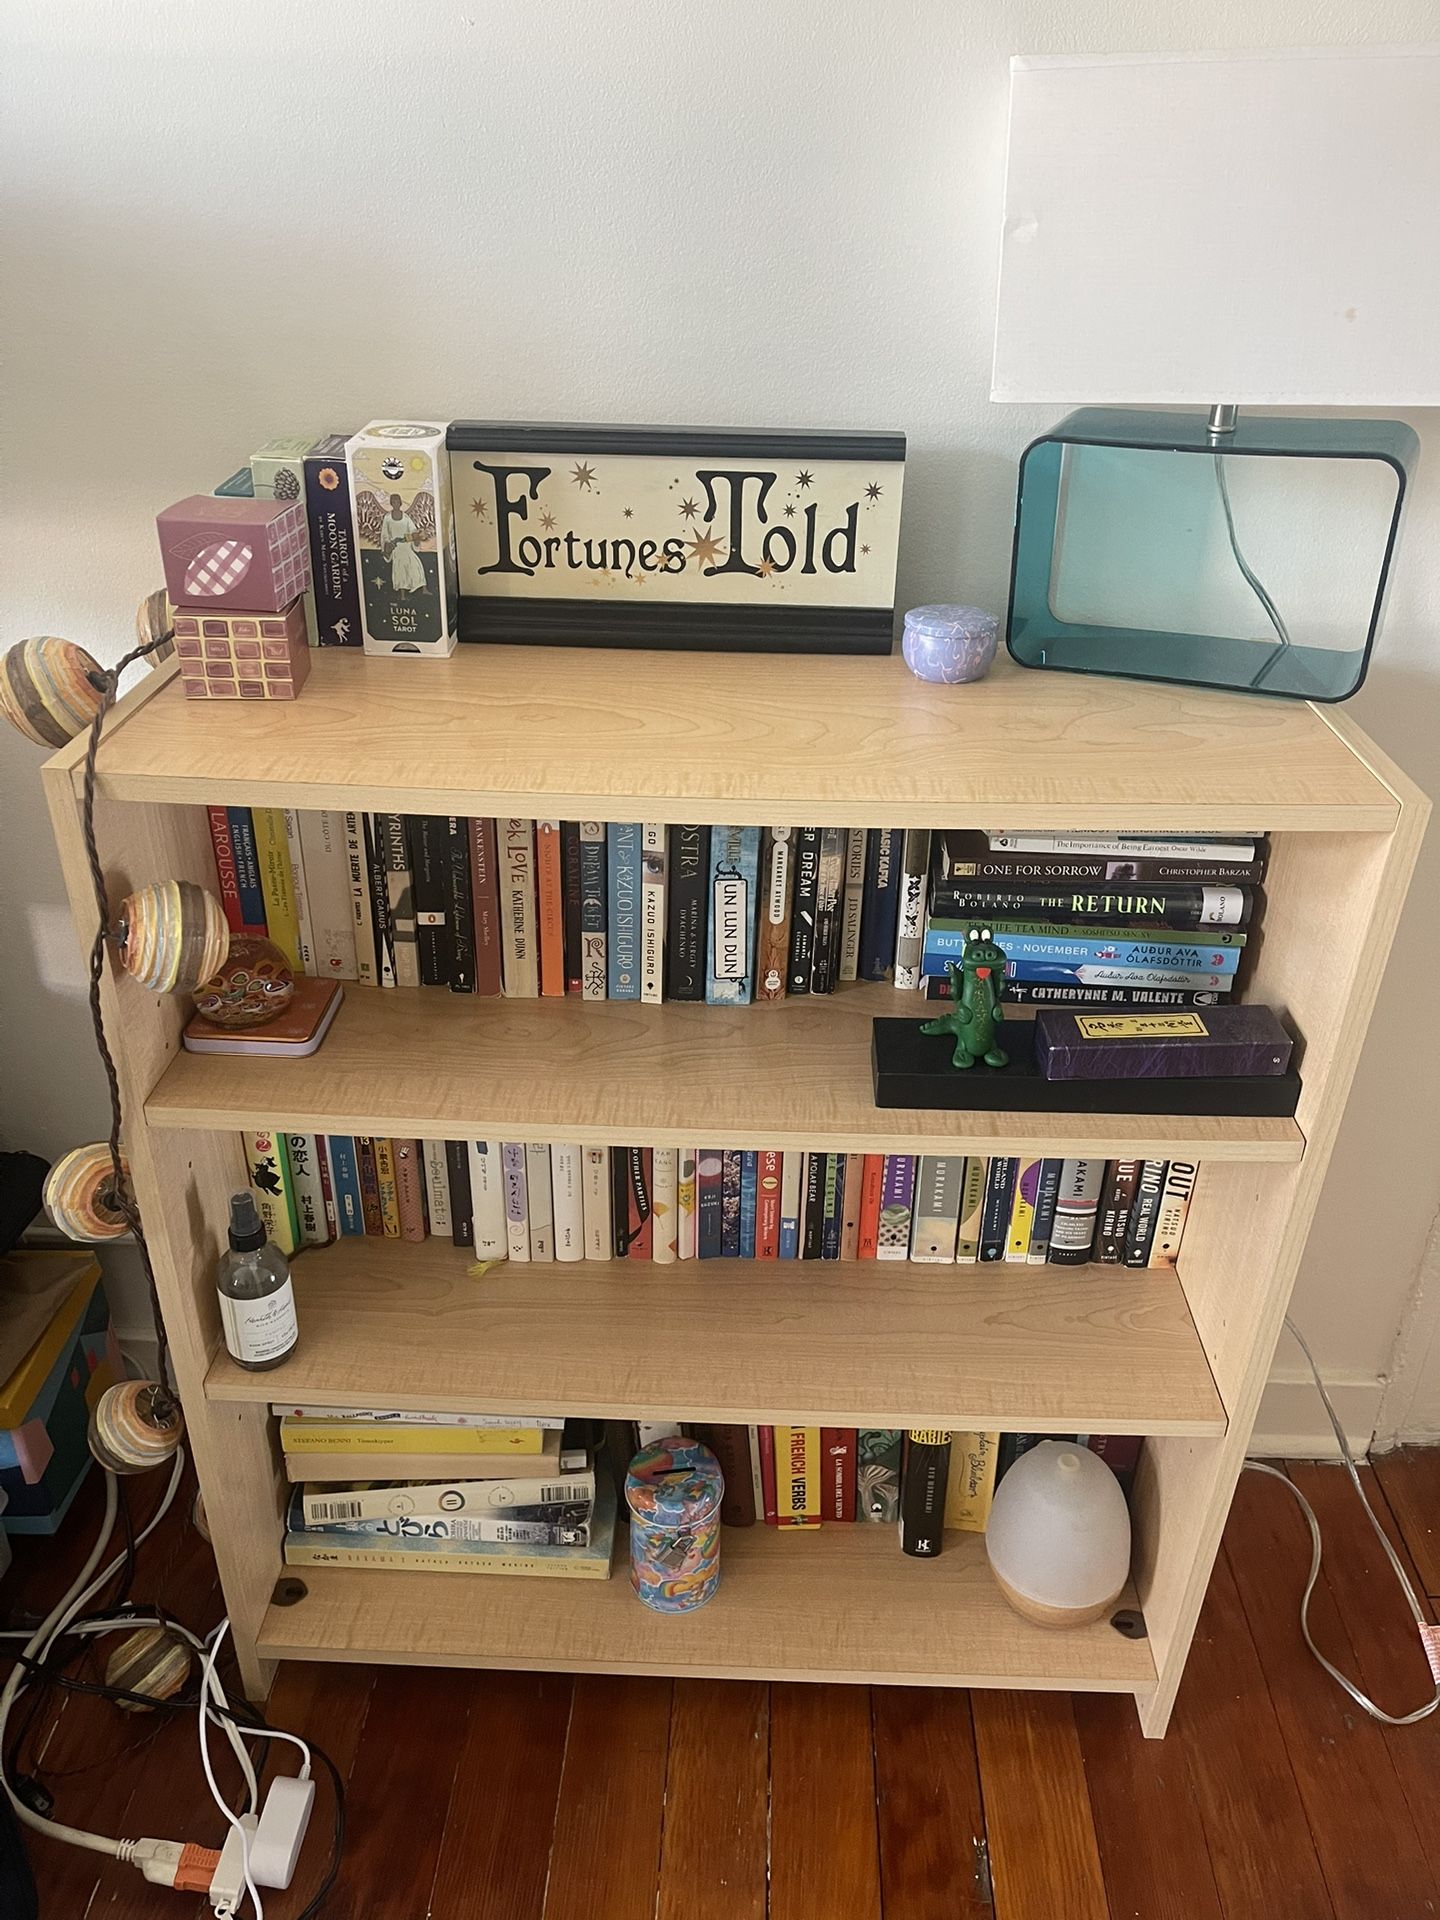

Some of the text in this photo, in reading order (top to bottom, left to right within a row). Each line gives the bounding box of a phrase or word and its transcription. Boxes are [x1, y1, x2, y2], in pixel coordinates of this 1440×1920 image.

[473, 460, 860, 578] Fortunes Told
[327, 512, 342, 600] MOON GARDEN
[338, 529, 349, 566] TAROT
[390, 607, 417, 615] LUNA
[392, 616, 418, 626] SOL
[211, 812, 238, 899] LAROUSSE
[232, 824, 247, 889] ENGLISH FRENCH
[349, 839, 358, 849] DE
[388, 813, 406, 871] YRINTHS
[475, 818, 486, 885] RANKENSTEIN
[850, 830, 862, 879] STORIES
[1069, 841, 1111, 849] Importance
[1111, 842, 1120, 850] of
[1121, 843, 1142, 852] Being
[1142, 844, 1169, 852] Earnest
[351, 855, 361, 882] MUERTE
[773, 850, 784, 918] MARGARET ATWOOD
[800, 851, 814, 898] DREAM
[877, 856, 890, 889] KAFKA
[983, 864, 1102, 876] ONE FOR SORROW
[1159, 866, 1251, 876] CHRISTOPHER BARZAK
[354, 887, 363, 897] LA
[373, 863, 387, 929] ALBERT CAMUS
[953, 890, 1025, 902] ROBERTO
[1039, 894, 1166, 914] THE RETURN
[512, 890, 526, 960] KATHERINE DUNN
[616, 865, 635, 970] KAZUO ISHIGURO
[690, 899, 698, 930] MARINA
[724, 884, 737, 974] UN LUN DUN
[1014, 924, 1036, 934] TEA
[1038, 925, 1069, 935] MIND
[646, 890, 656, 975] KAZUO ISHIGURO
[845, 912, 857, 958] SALINGER
[689, 940, 697, 969] SERGEY
[1022, 944, 1089, 956] NOVEMBER
[1125, 954, 1203, 967] ÓLAFSDÓTTIR
[1175, 948, 1199, 958] AVA
[1032, 986, 1185, 1004] CATHERYNNE M. VALENTE
[632, 1156, 641, 1180] OTHER
[809, 1162, 817, 1184] POLAR
[893, 1157, 906, 1199] URAKAMI
[994, 1161, 1003, 1190] WORLD
[1000, 1157, 1008, 1189] ERLAND
[1073, 1160, 1087, 1197] AKAMI
[1165, 1162, 1195, 1202] OUT
[635, 1181, 648, 1211] PARTIES
[808, 1185, 816, 1202] BEAR
[932, 1161, 947, 1213] MURAKAMI
[968, 1166, 980, 1208] MURAKAMI
[1019, 1182, 1030, 1218] MURAKAMI
[1040, 1173, 1056, 1221] MURAKAMI
[301, 1195, 316, 1232] 村上春樹
[1102, 1210, 1115, 1237] KIRINO
[1115, 1209, 1128, 1238] NATSUO
[1135, 1198, 1153, 1242] REAL WORLD
[1161, 1209, 1172, 1236] KIRINO
[1168, 1209, 1181, 1236] NATSUO
[790, 1432, 806, 1511] FRENCH VERBS
[925, 1466, 936, 1514] RYU MURAKAMI
[376, 1516, 449, 1538] とびら
